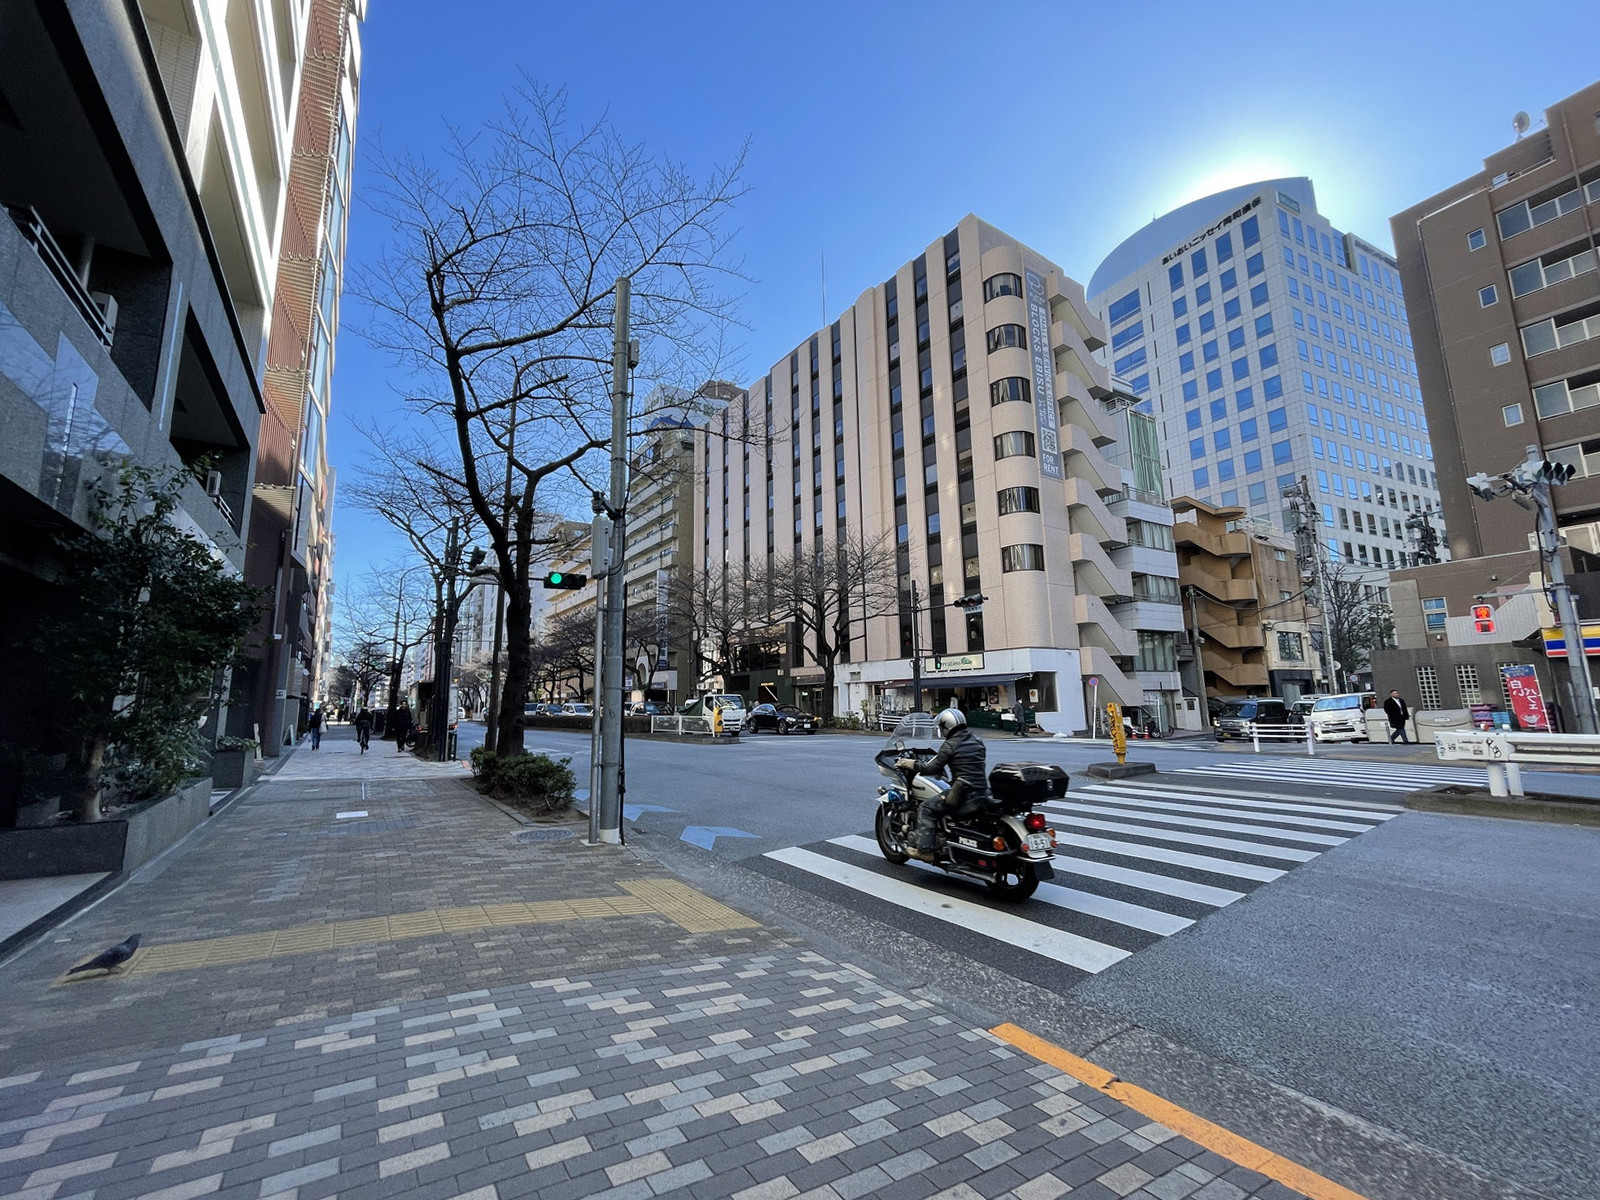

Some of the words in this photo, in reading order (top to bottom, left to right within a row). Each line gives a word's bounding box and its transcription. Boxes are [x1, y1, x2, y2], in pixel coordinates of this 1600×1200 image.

[1162, 196, 1262, 266] あいおいニッセイ同和損保
[1030, 303, 1041, 353] BLOCKS
[1035, 357, 1045, 395] EBISU
[1043, 350, 1052, 391] SERVICES
[1047, 393, 1055, 422] OFFICE
[1042, 453, 1055, 464] FOR
[1043, 463, 1059, 474] RENT
[958, 836, 978, 848] POLICE
